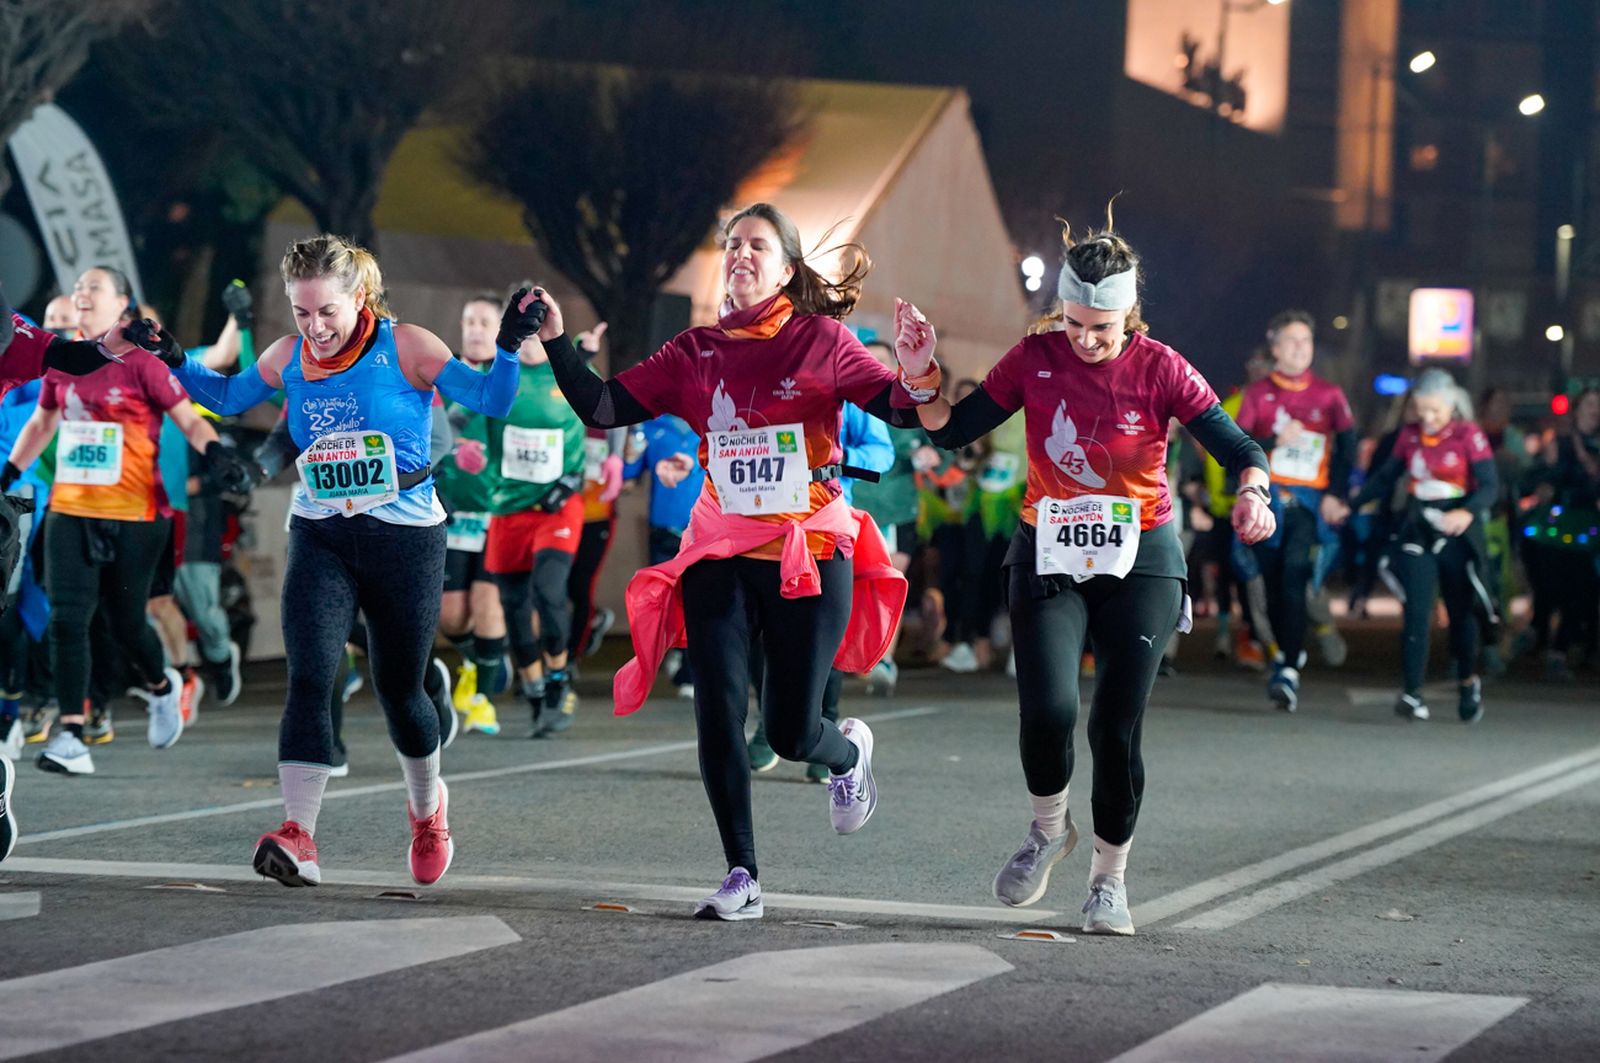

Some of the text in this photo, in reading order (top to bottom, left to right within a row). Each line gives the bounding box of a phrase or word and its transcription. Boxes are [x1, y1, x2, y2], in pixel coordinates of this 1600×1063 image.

[65, 150, 124, 266] MASA
[309, 407, 336, 431] 25
[316, 439, 357, 451] NOCHE DE
[729, 435, 756, 446] NOCHE
[758, 434, 769, 444] DE
[307, 453, 324, 463] SAN
[325, 447, 357, 461] ANTÓN
[718, 448, 737, 458] SAN
[738, 444, 770, 456] ANTÓN
[729, 456, 785, 485] 6147
[1059, 450, 1085, 475] 43
[311, 457, 385, 490] 13002
[328, 489, 348, 498] JUANA
[1061, 505, 1090, 515] NOCHE
[1092, 503, 1103, 512] DE
[1049, 515, 1070, 524] SAN
[1071, 511, 1103, 522] ANTÓN
[1056, 523, 1123, 547] 4664
